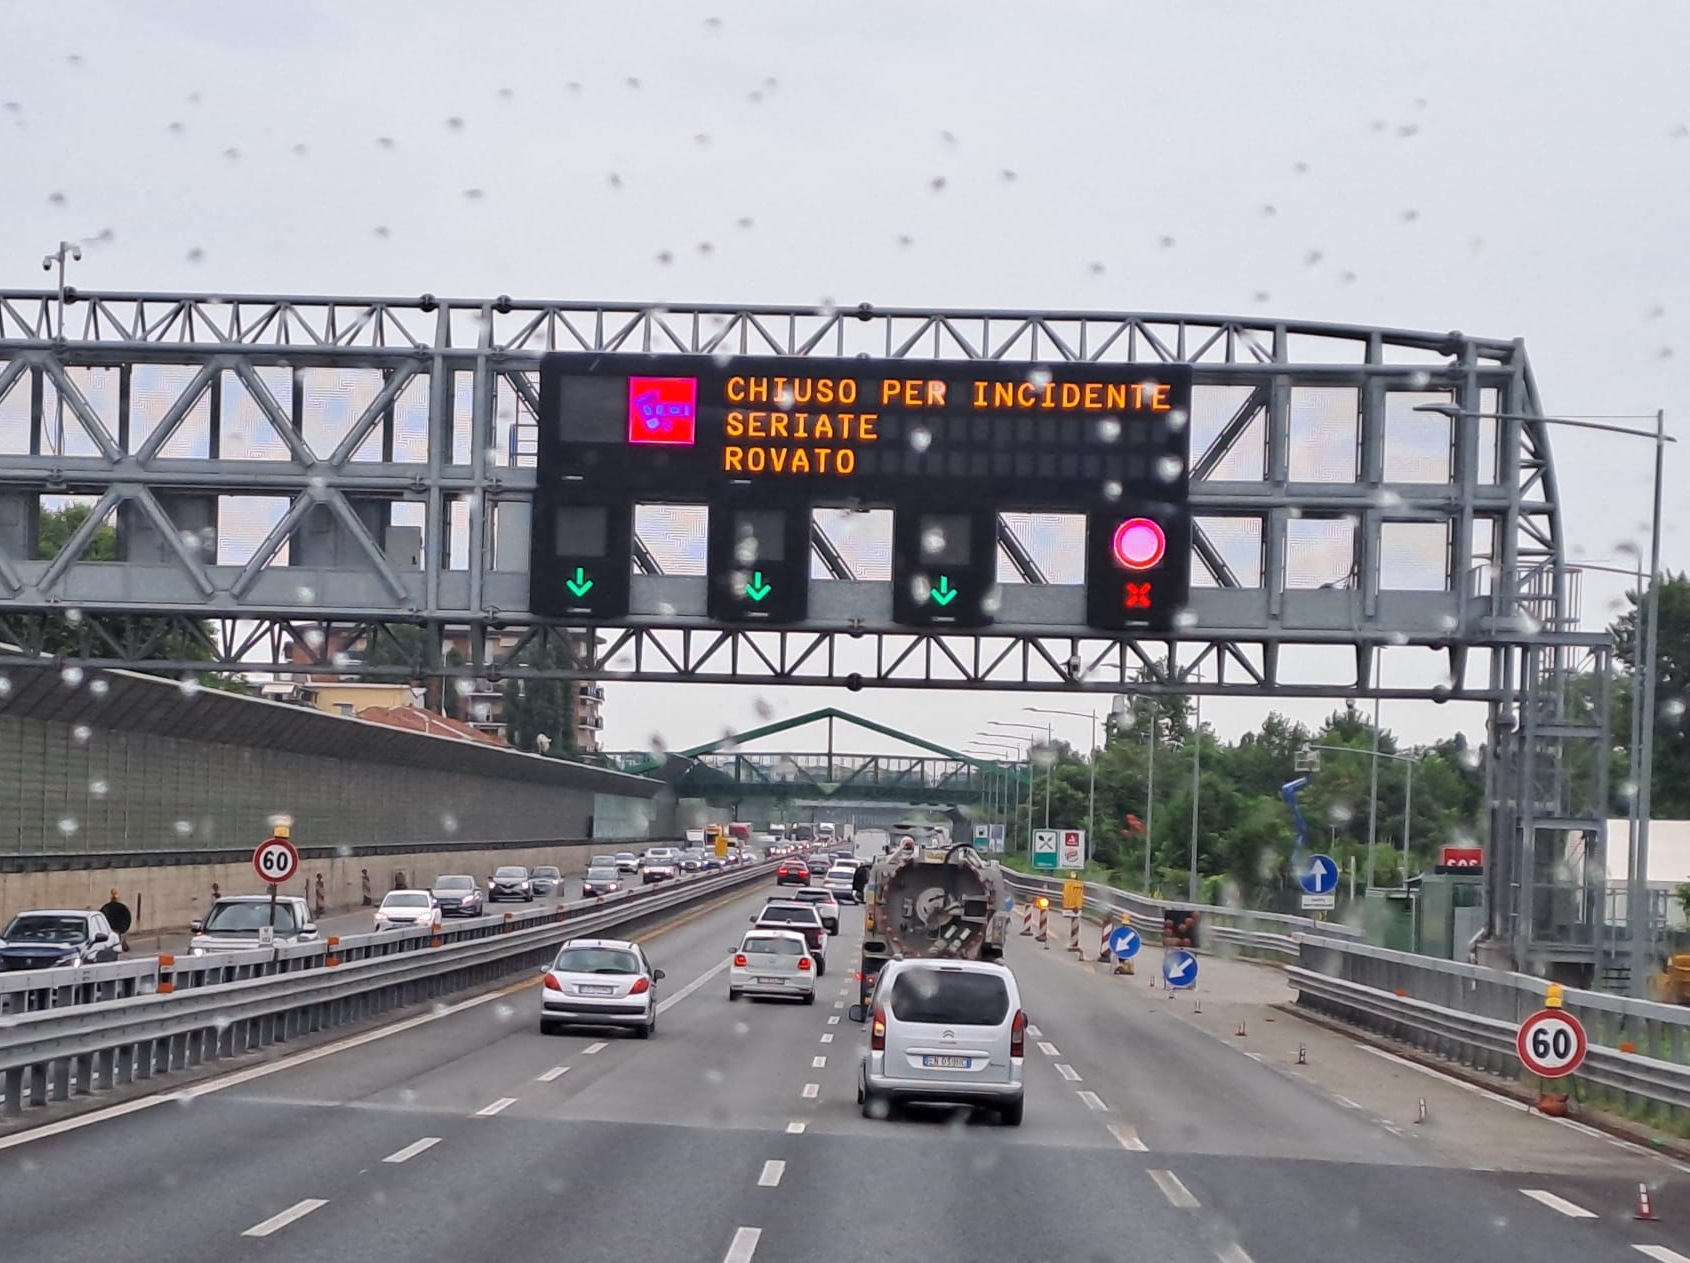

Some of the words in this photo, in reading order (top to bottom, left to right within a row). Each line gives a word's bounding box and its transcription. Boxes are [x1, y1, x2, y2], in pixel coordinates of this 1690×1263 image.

[726, 376, 857, 404] CHIUSO
[882, 379, 947, 406] PER
[973, 381, 1171, 410] INCIDENTE
[726, 411, 878, 440] SERIATE
[724, 446, 855, 474] ROVATO
[263, 851, 287, 871] 60
[1533, 1028, 1571, 1059] 60
